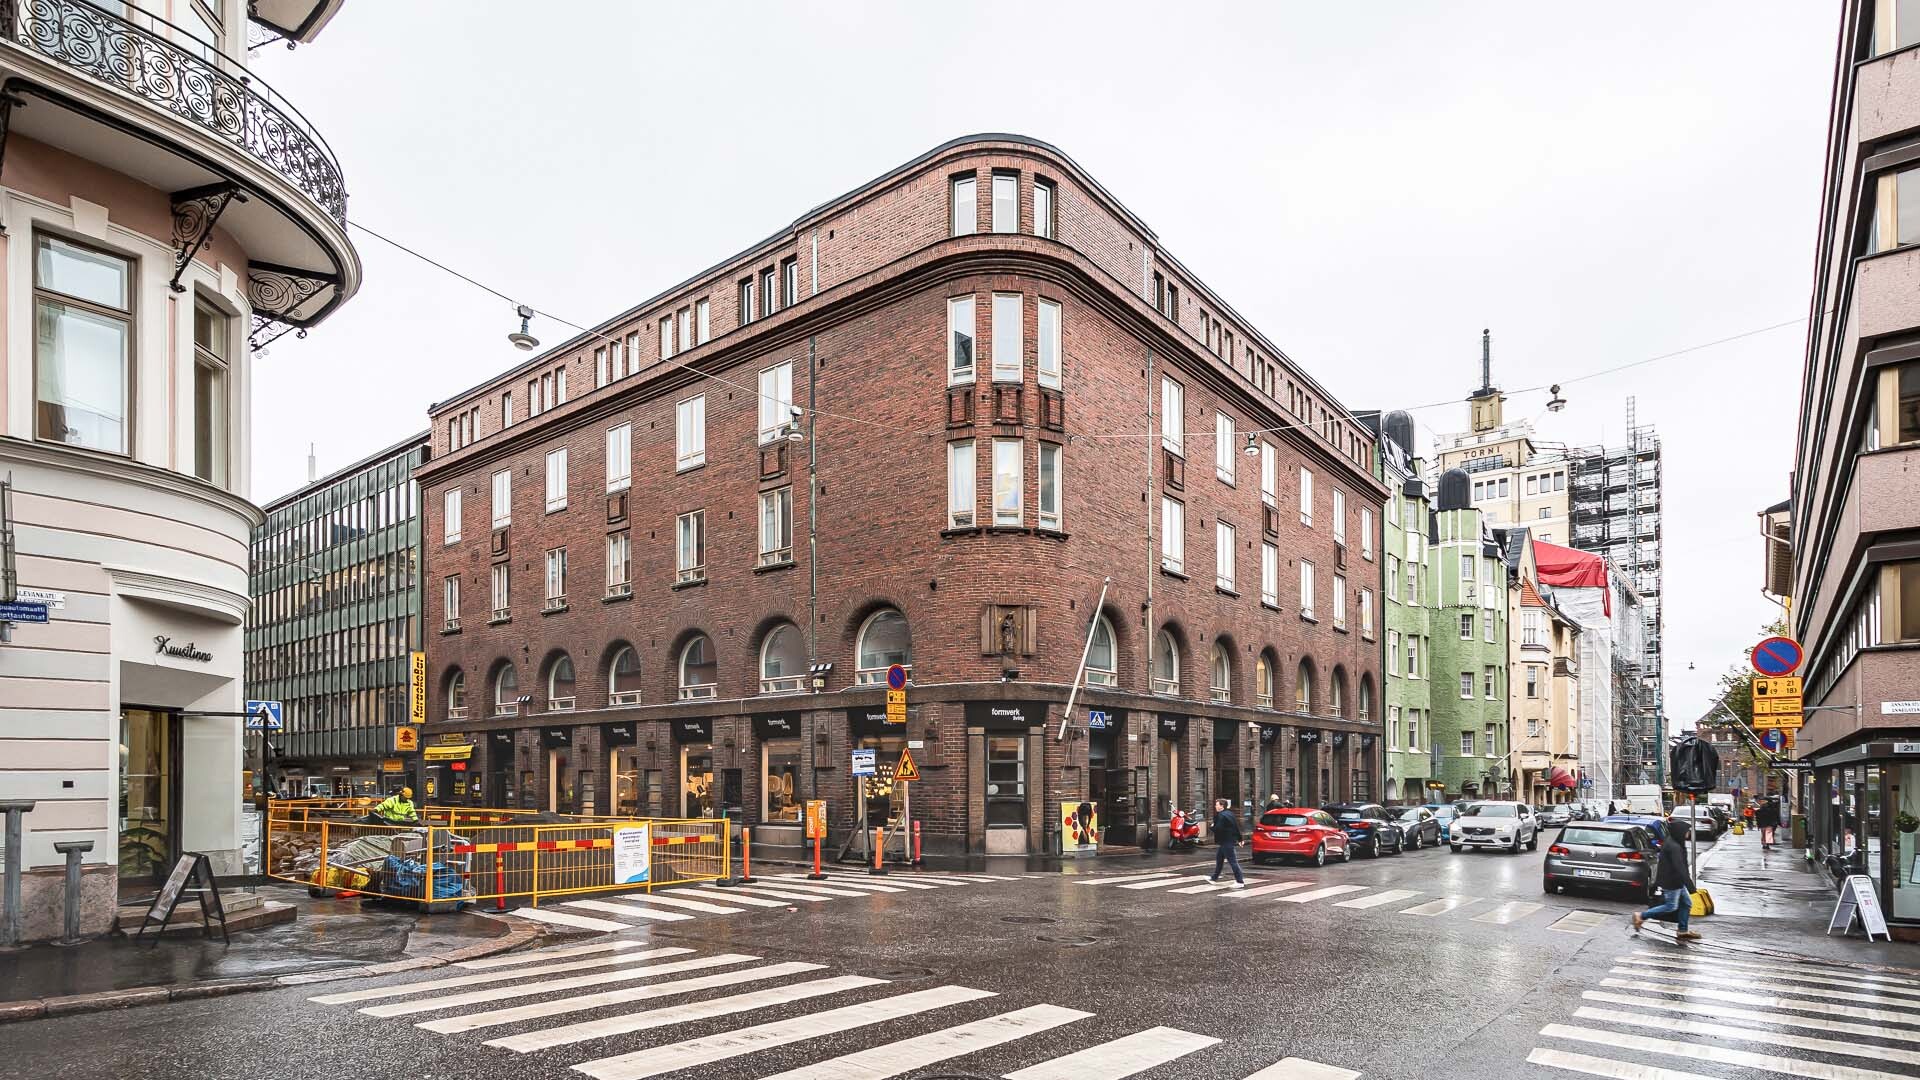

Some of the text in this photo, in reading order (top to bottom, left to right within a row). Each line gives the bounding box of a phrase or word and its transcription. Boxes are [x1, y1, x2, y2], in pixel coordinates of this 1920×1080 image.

[1463, 446, 1500, 459] TORNI
[991, 707, 1020, 716] formverk
[1903, 744, 1914, 752] 21
